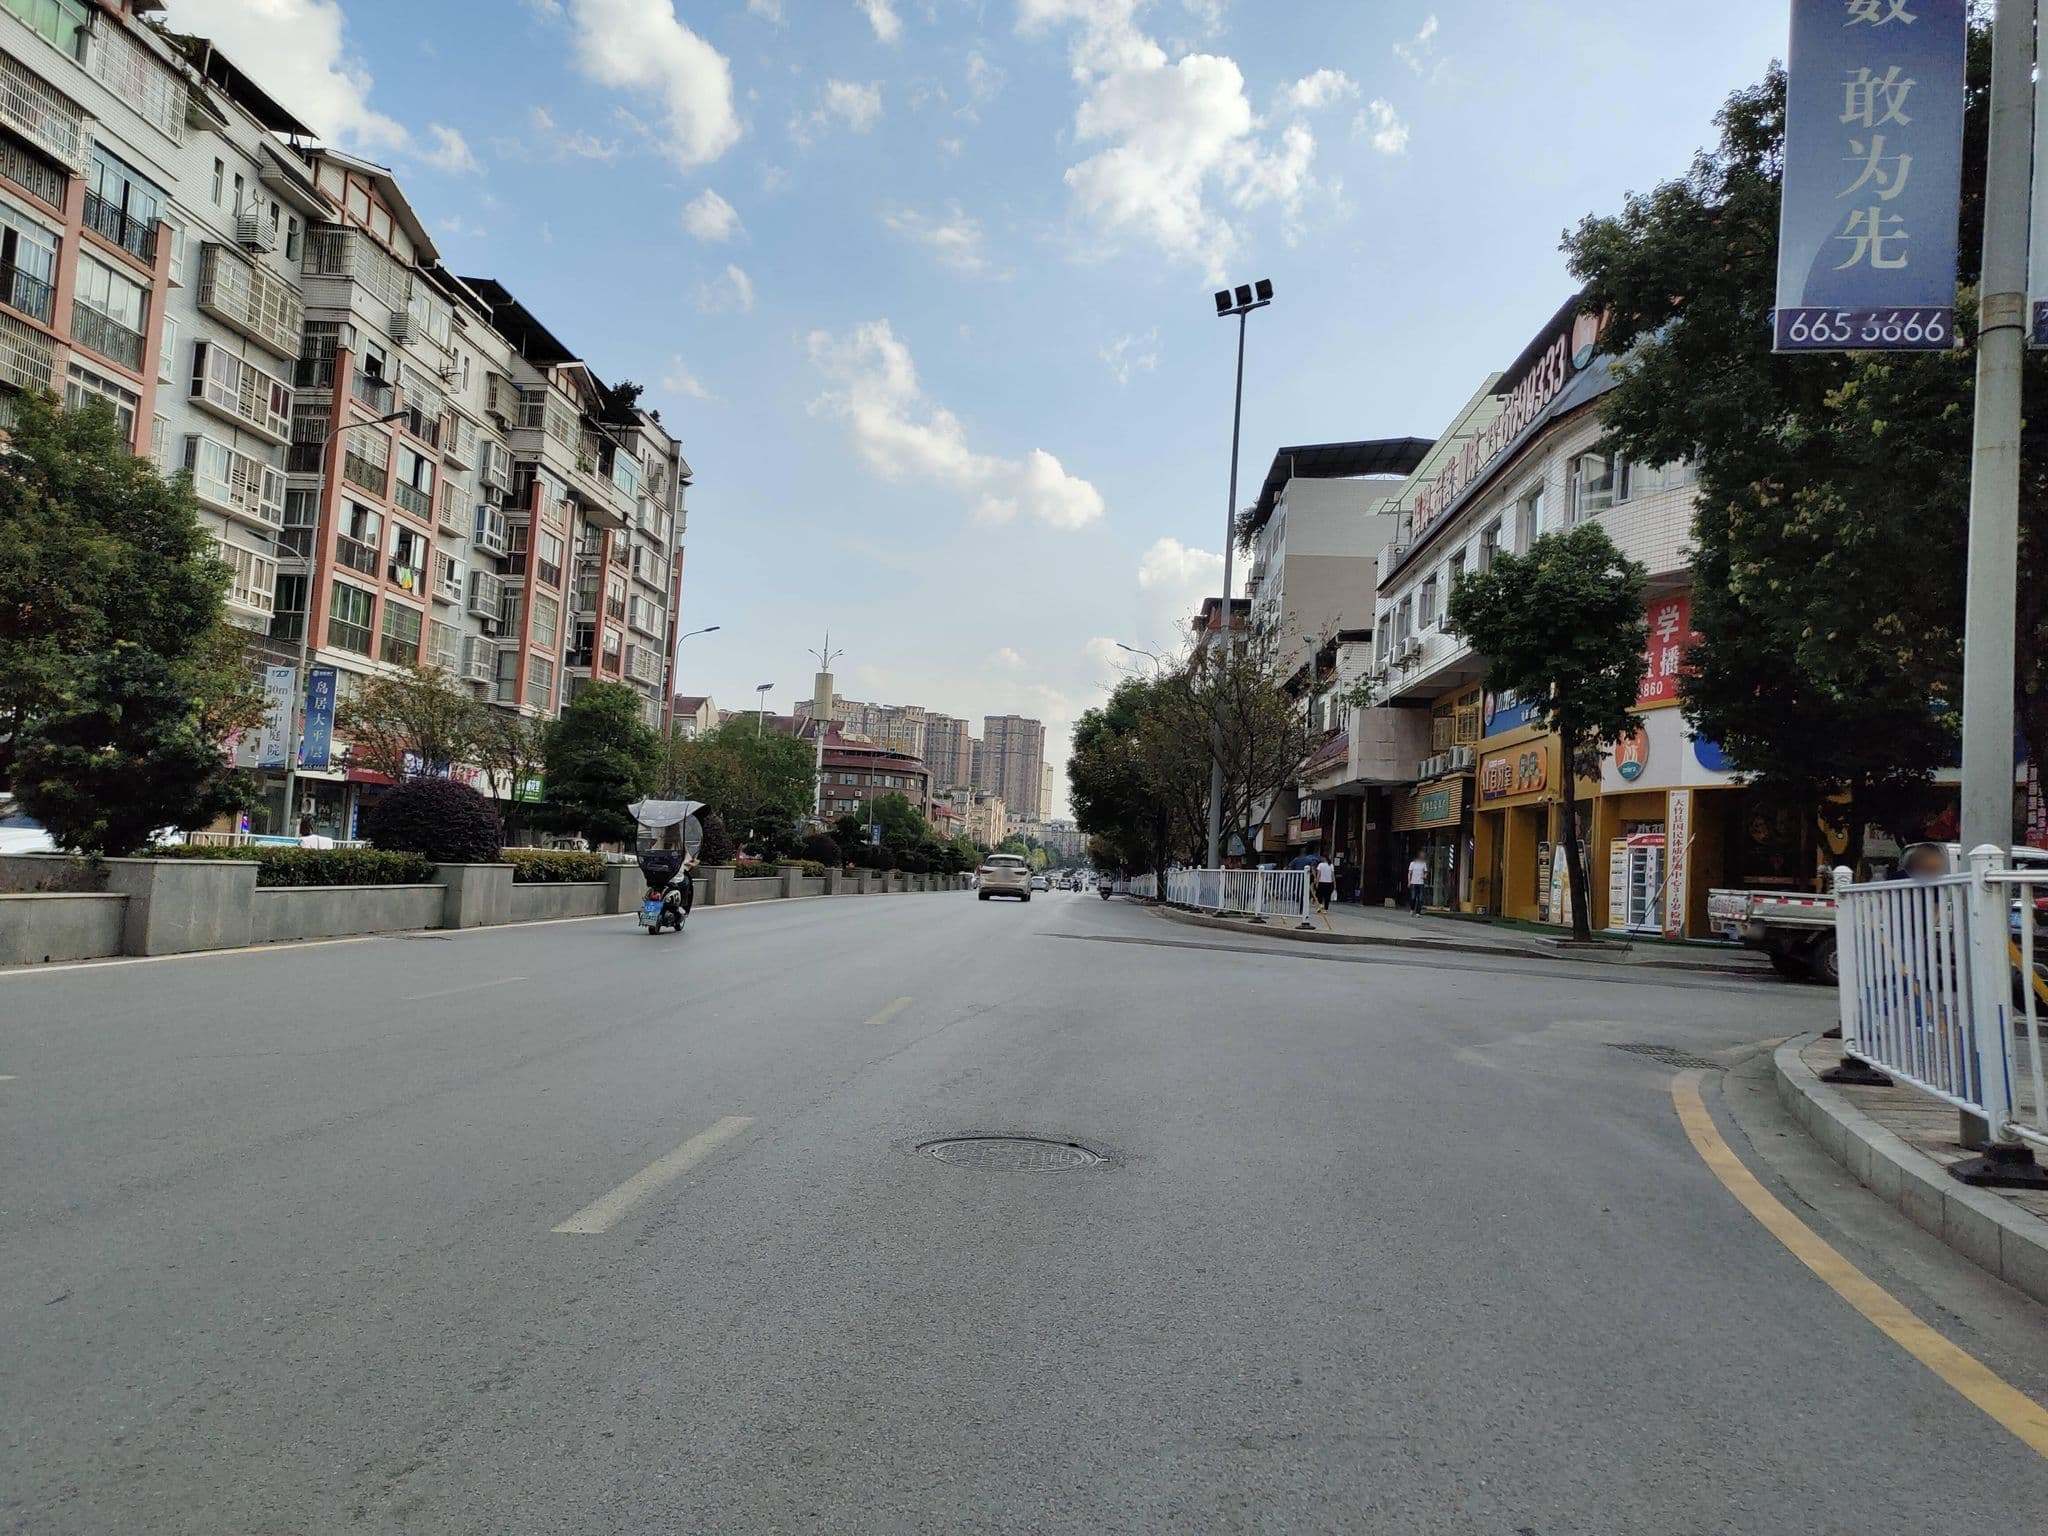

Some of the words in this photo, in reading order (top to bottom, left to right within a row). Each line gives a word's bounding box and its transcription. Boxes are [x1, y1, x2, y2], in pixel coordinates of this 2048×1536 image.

[1832, 65, 1917, 270] 敢为先
[1789, 312, 1852, 343] 665
